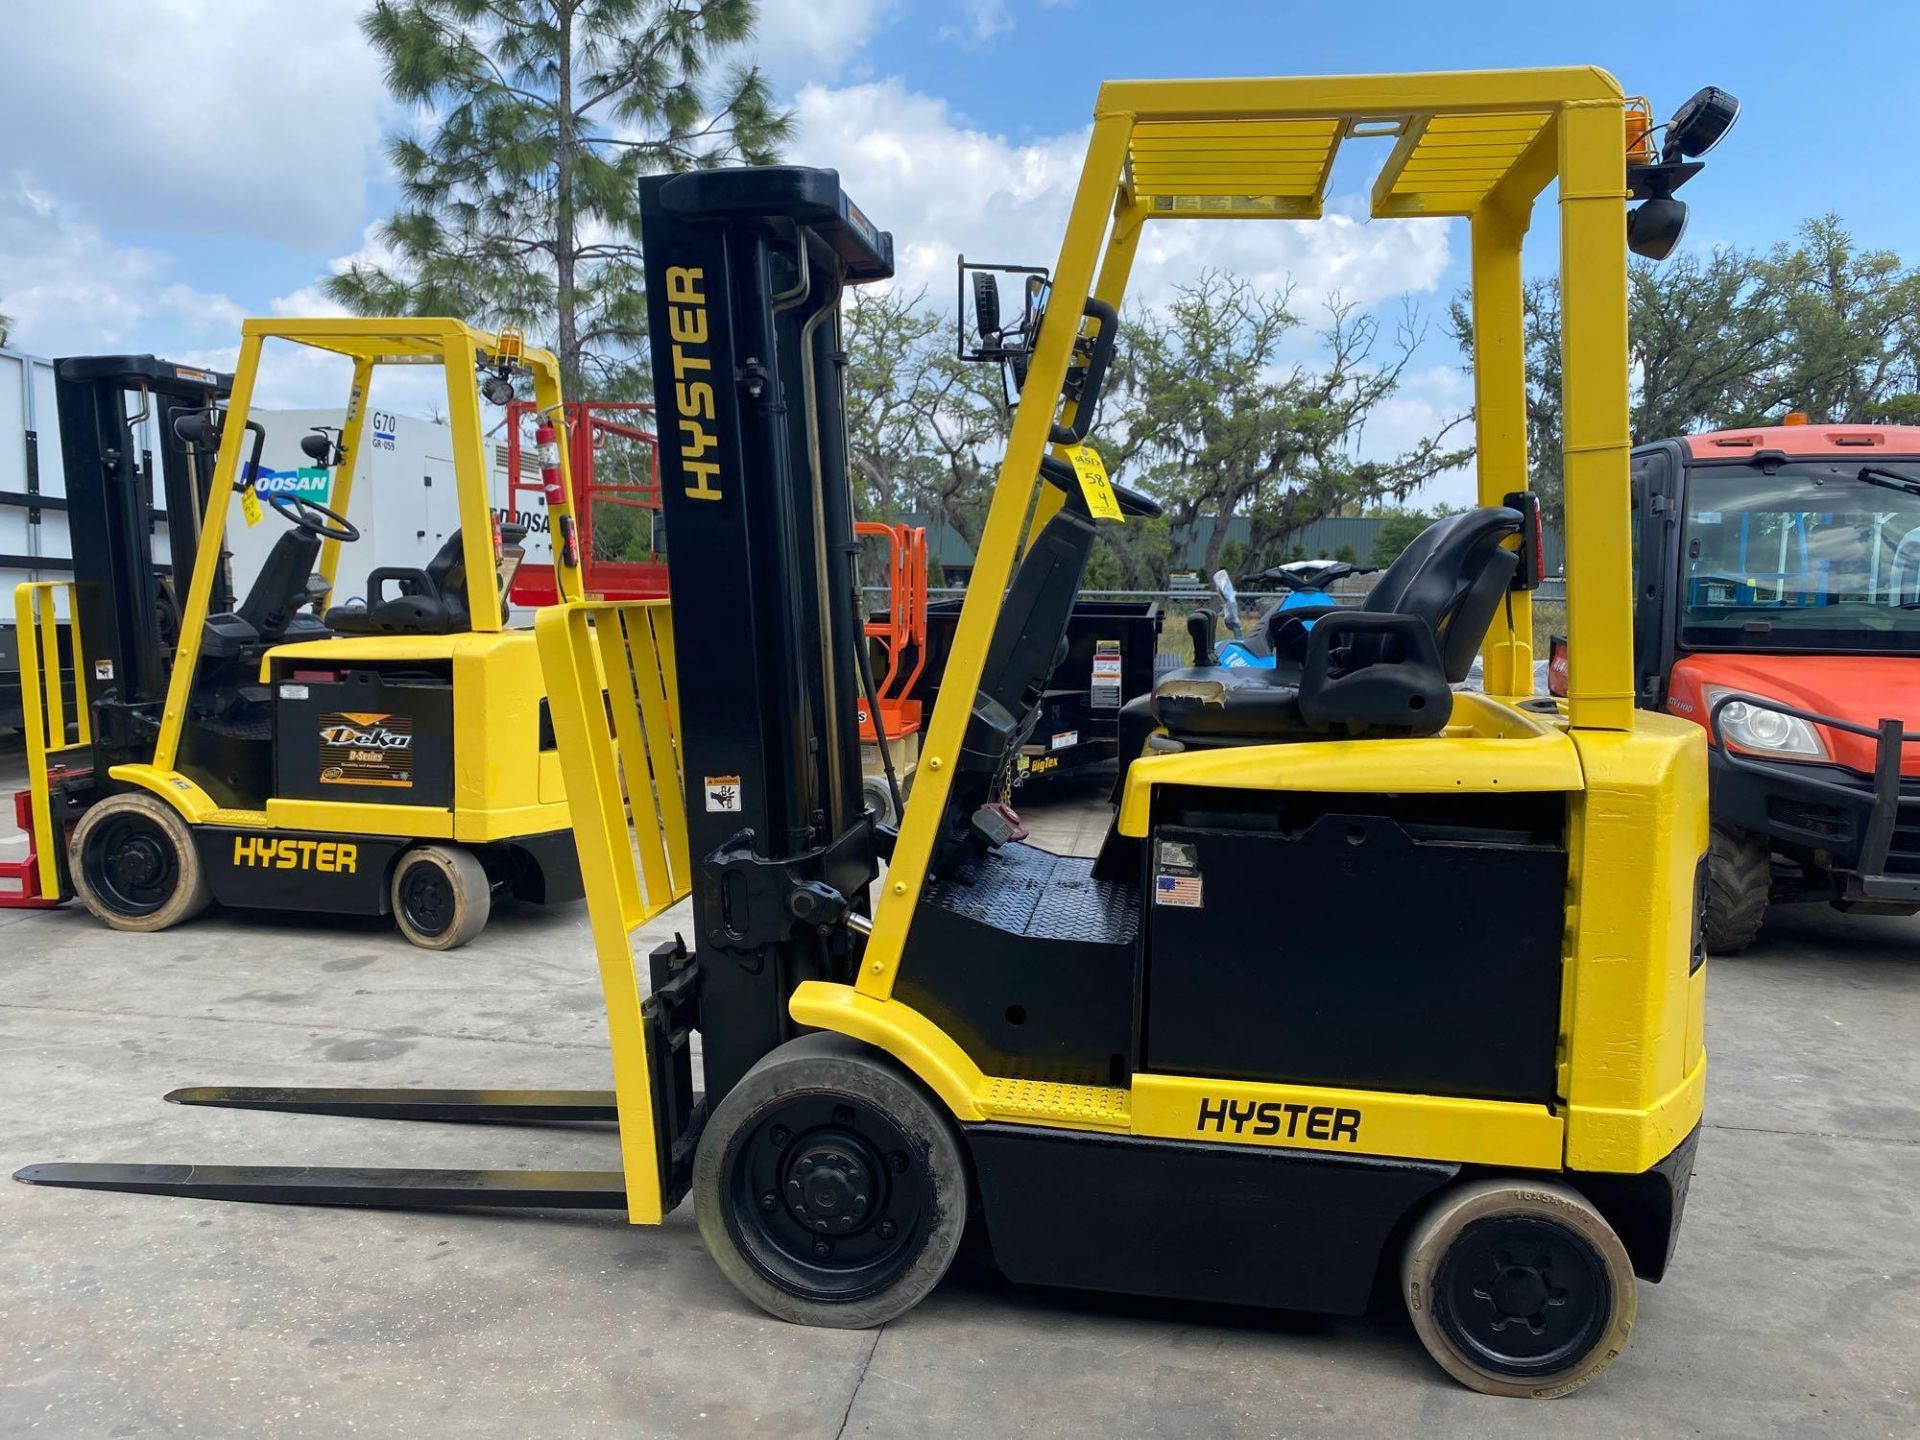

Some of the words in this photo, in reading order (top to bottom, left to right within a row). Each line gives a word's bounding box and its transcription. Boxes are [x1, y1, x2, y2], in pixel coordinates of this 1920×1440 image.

[666, 266, 722, 500] HYSTER
[373, 411, 395, 433] G70
[242, 477, 326, 491] OOSAN
[320, 726, 411, 749] Deka
[233, 836, 357, 874] HYSTER
[1197, 1097, 1362, 1143] HYSTER
